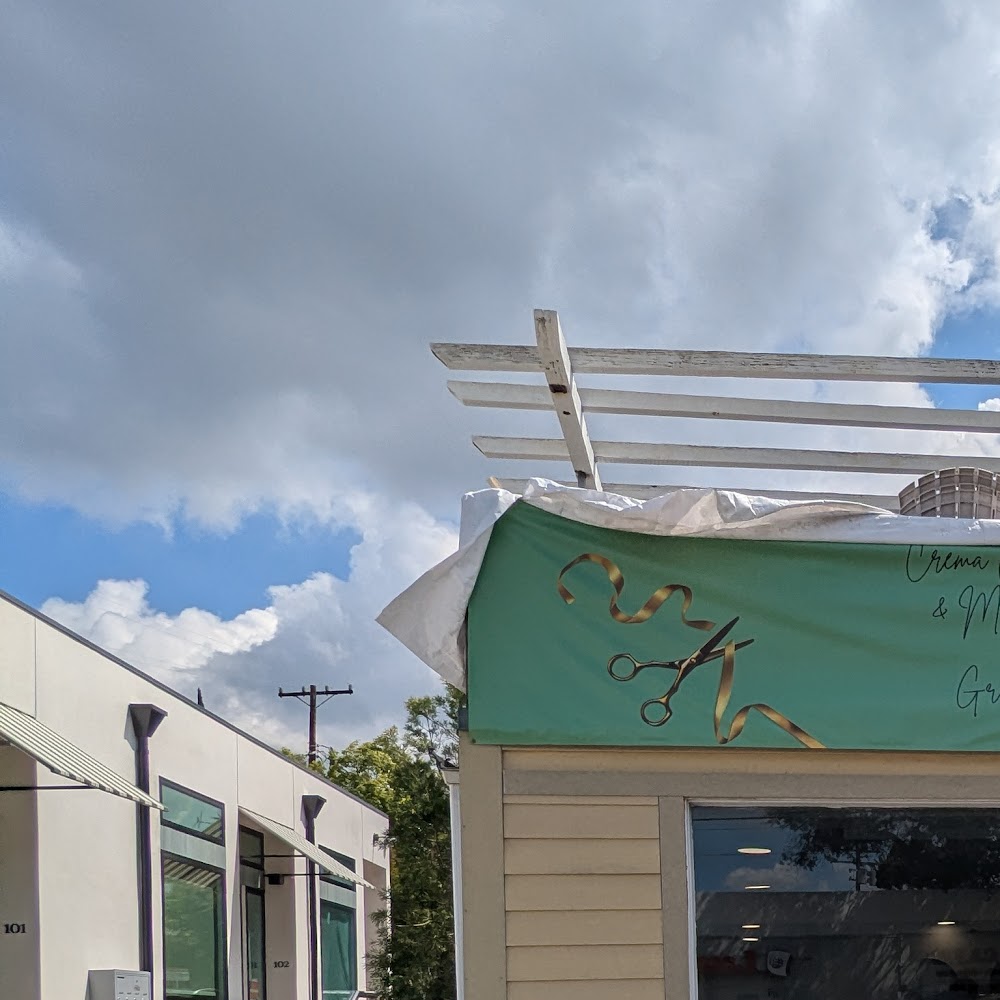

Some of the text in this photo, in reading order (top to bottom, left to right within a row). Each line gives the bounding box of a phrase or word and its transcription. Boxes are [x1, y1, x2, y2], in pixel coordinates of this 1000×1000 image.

[906, 544, 990, 583] Crema
[932, 597, 948, 619] &
[4, 923, 26, 934] 101
[273, 960, 290, 969] 102
